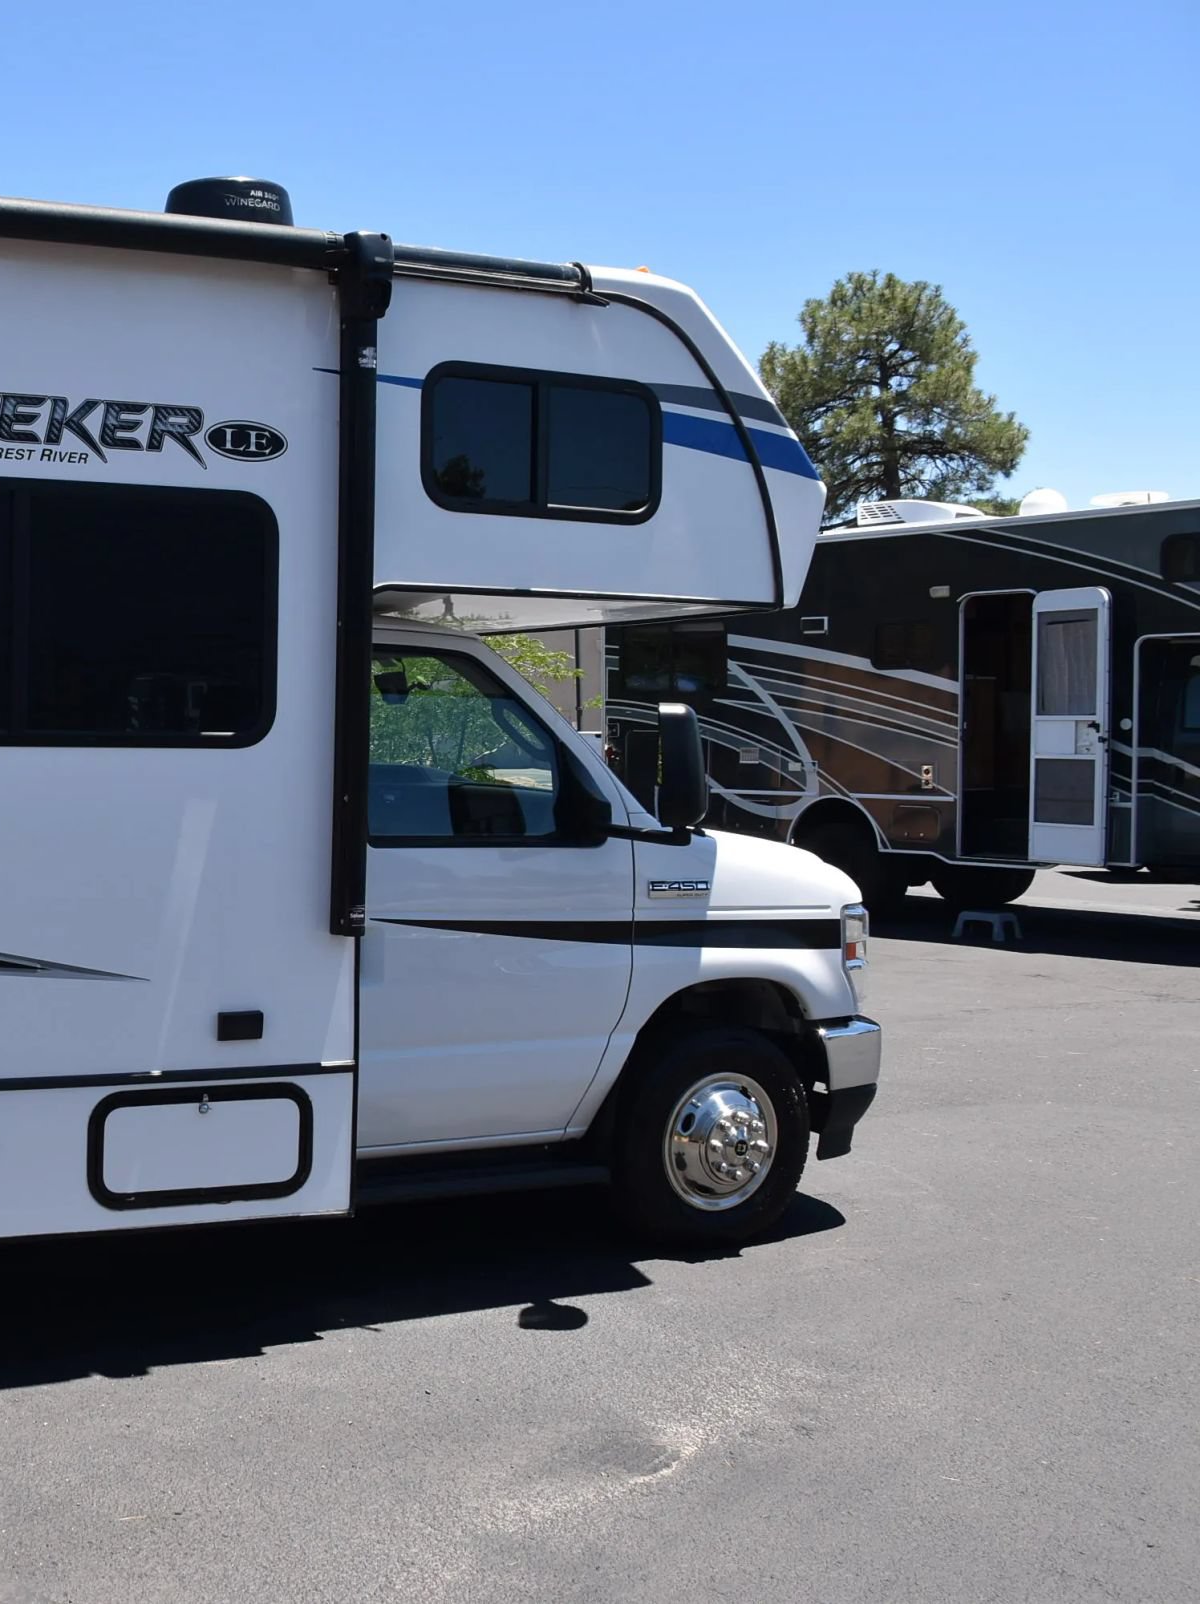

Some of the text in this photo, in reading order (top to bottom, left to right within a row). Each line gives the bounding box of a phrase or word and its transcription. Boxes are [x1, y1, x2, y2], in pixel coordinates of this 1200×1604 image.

[249, 189, 263, 198] AIR
[223, 197, 281, 212] WINEGARD
[219, 427, 273, 456] LE
[39, 447, 90, 465] RIVER
